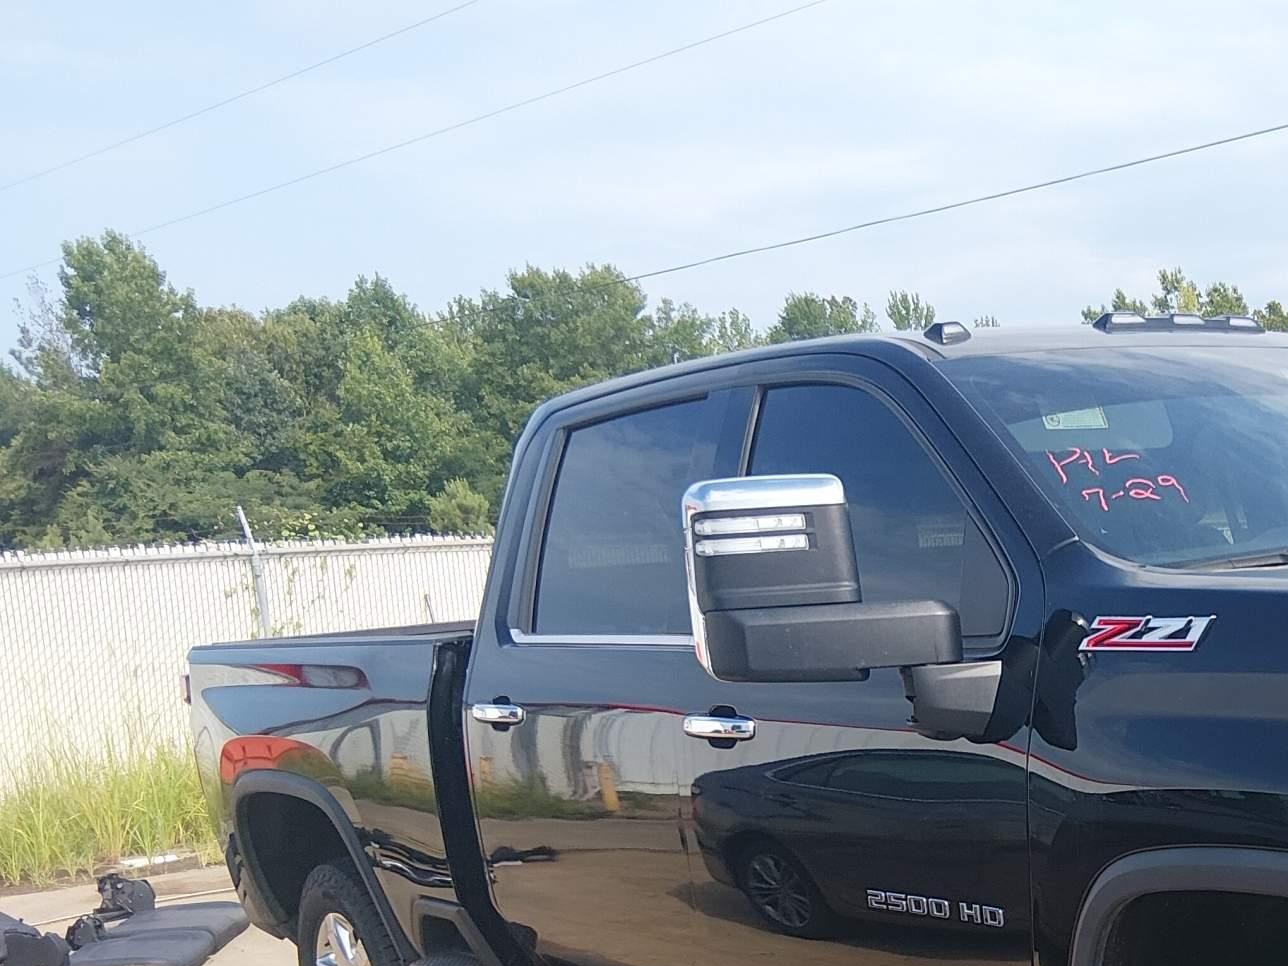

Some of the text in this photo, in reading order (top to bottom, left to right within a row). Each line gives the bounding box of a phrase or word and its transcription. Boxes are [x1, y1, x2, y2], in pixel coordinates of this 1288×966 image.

[1081, 474, 1190, 512] 7-29
[1078, 615, 1216, 652] Z71
[866, 888, 1005, 928] 2500 HD
